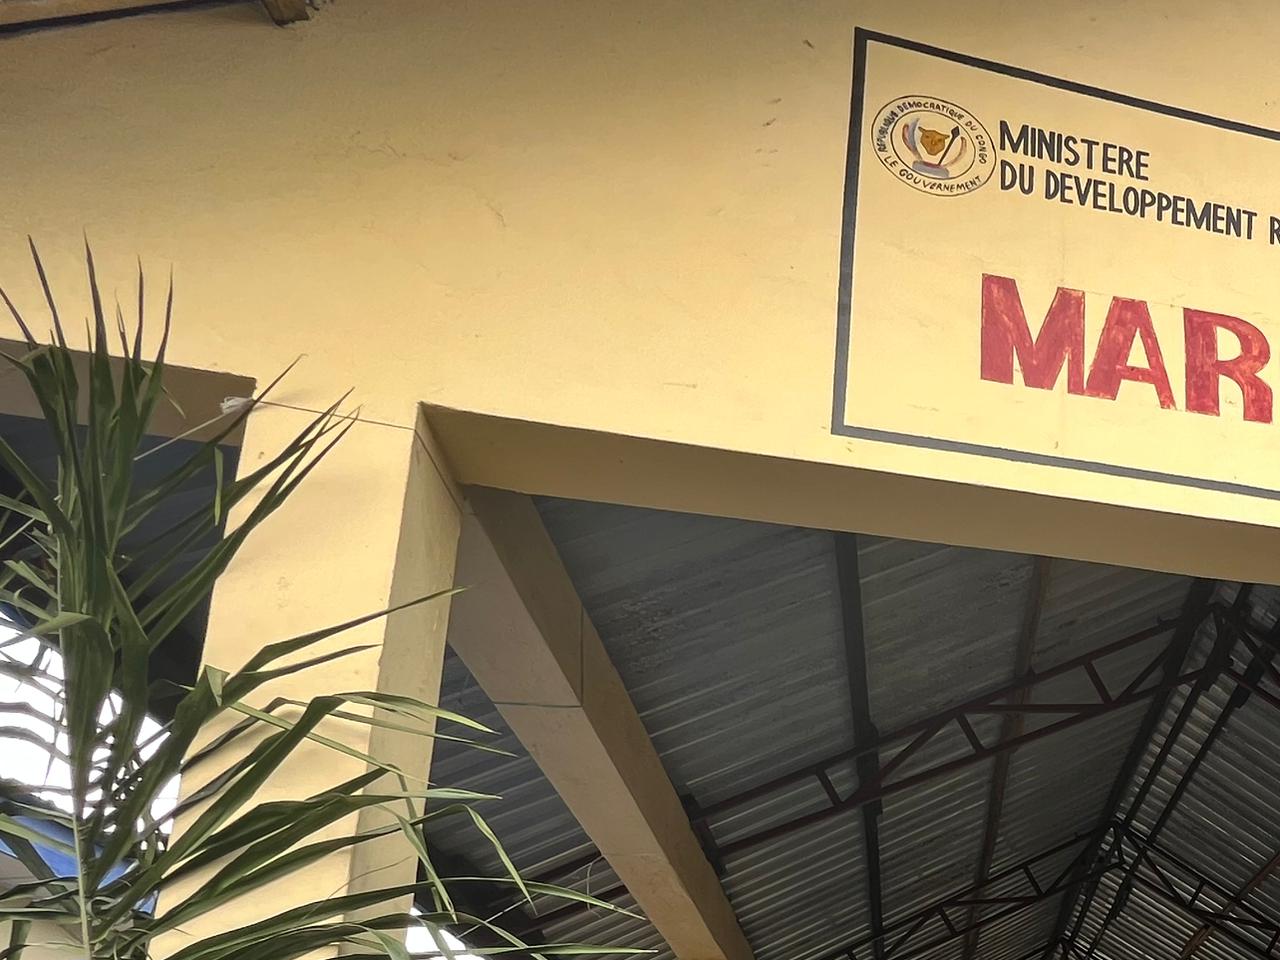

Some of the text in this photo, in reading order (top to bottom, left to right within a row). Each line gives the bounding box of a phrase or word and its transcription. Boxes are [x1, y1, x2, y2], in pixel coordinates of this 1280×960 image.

[884, 156, 982, 192] LE GOUVERNEMENT
[999, 119, 1151, 181] MINISTERE
[1000, 159, 1036, 195] DU
[1045, 169, 1257, 239] DEVELOPPEMENT
